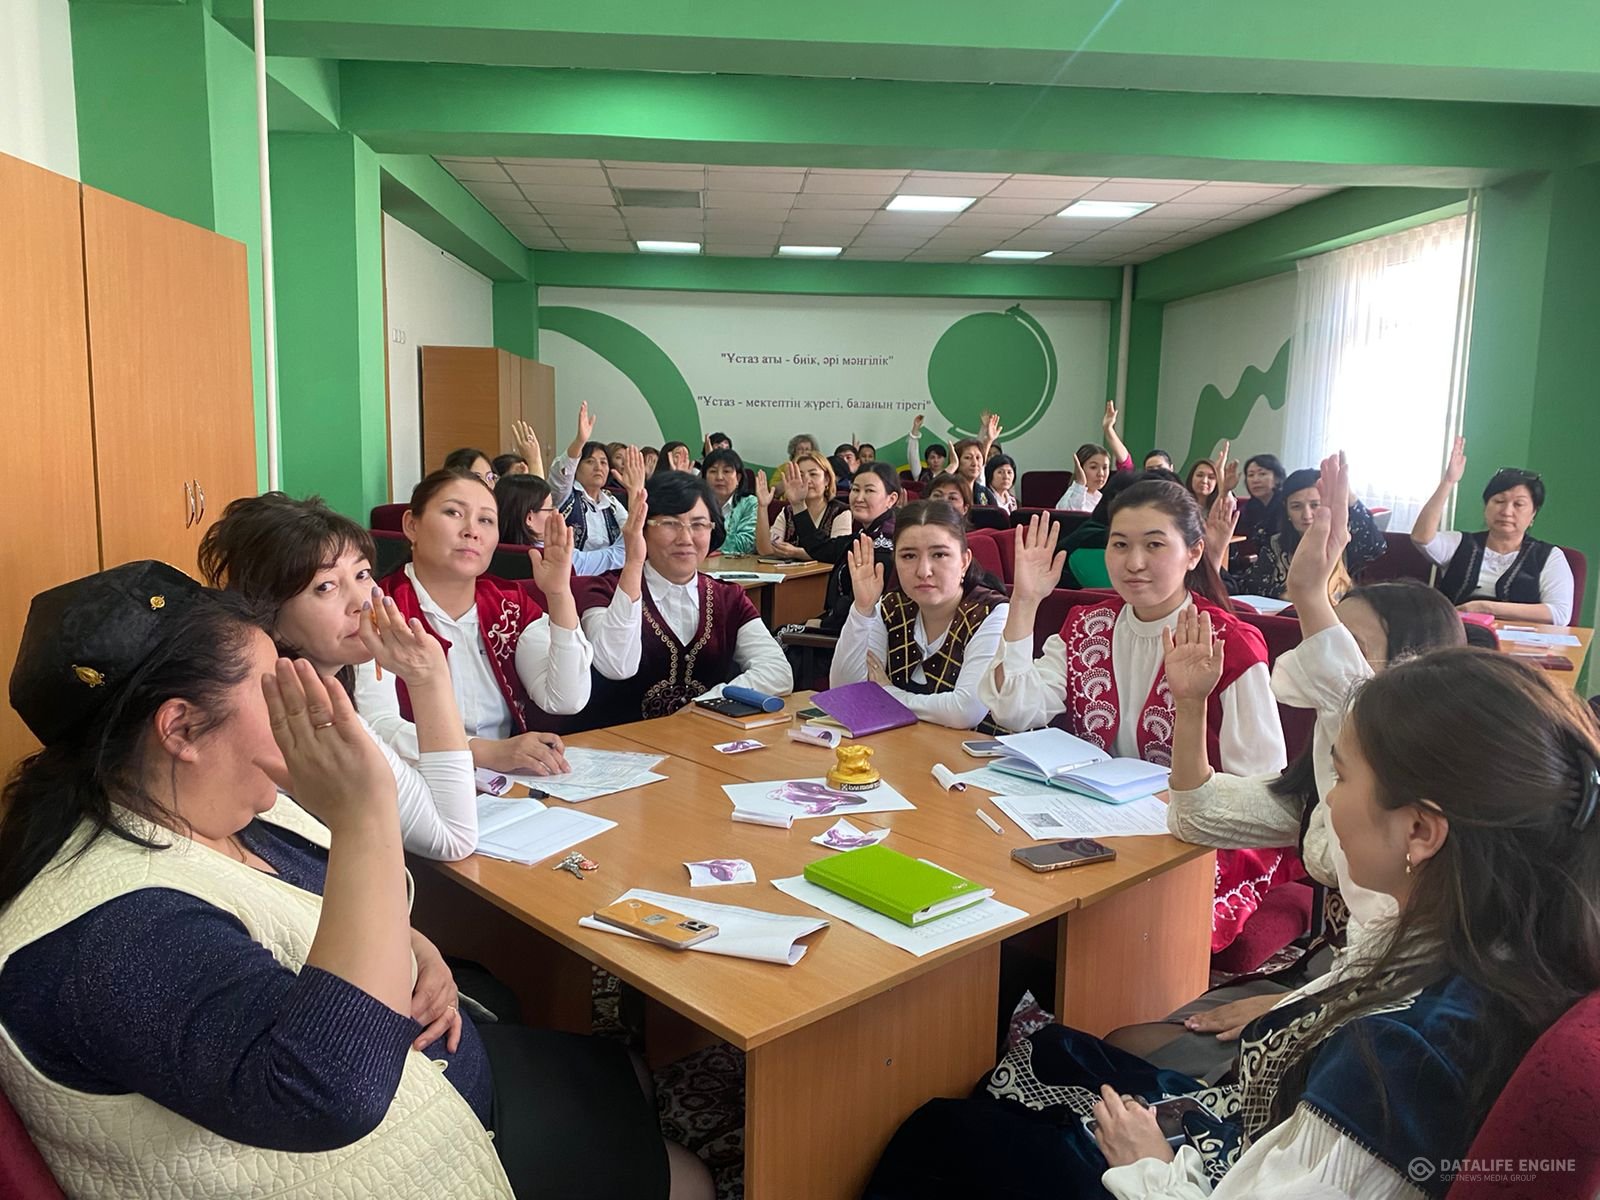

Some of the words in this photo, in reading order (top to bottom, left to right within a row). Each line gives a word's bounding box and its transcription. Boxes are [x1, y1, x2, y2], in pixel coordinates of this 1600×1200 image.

[762, 356, 782, 364] аты
[793, 354, 820, 366] биік,
[823, 355, 839, 367] әрі
[896, 399, 931, 412] тірегі"
